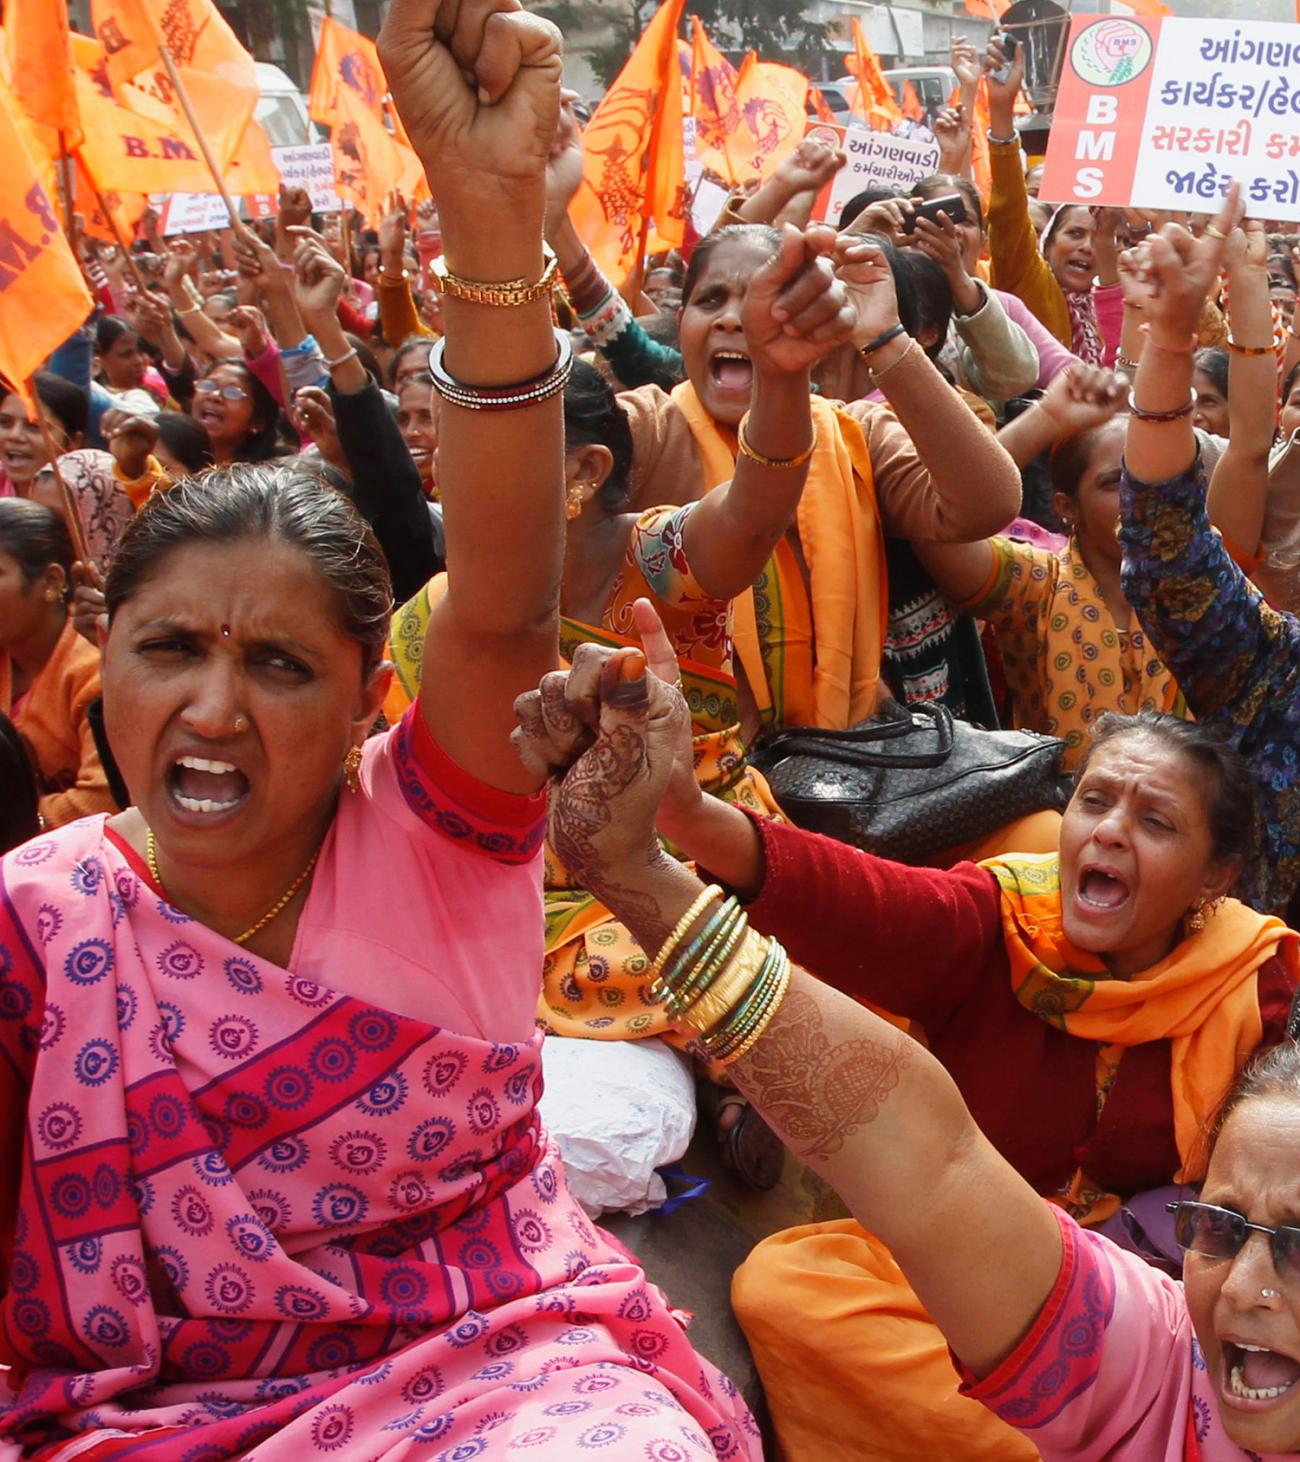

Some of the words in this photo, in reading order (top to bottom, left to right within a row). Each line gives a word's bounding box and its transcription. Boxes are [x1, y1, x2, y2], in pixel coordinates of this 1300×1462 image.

[1113, 38, 1137, 46] BMS
[848, 138, 940, 169] આંગણવાડી
[1151, 119, 1252, 156] સરકારી
[1166, 162, 1233, 198] જાહેર
[1249, 170, 1300, 204] કરો
